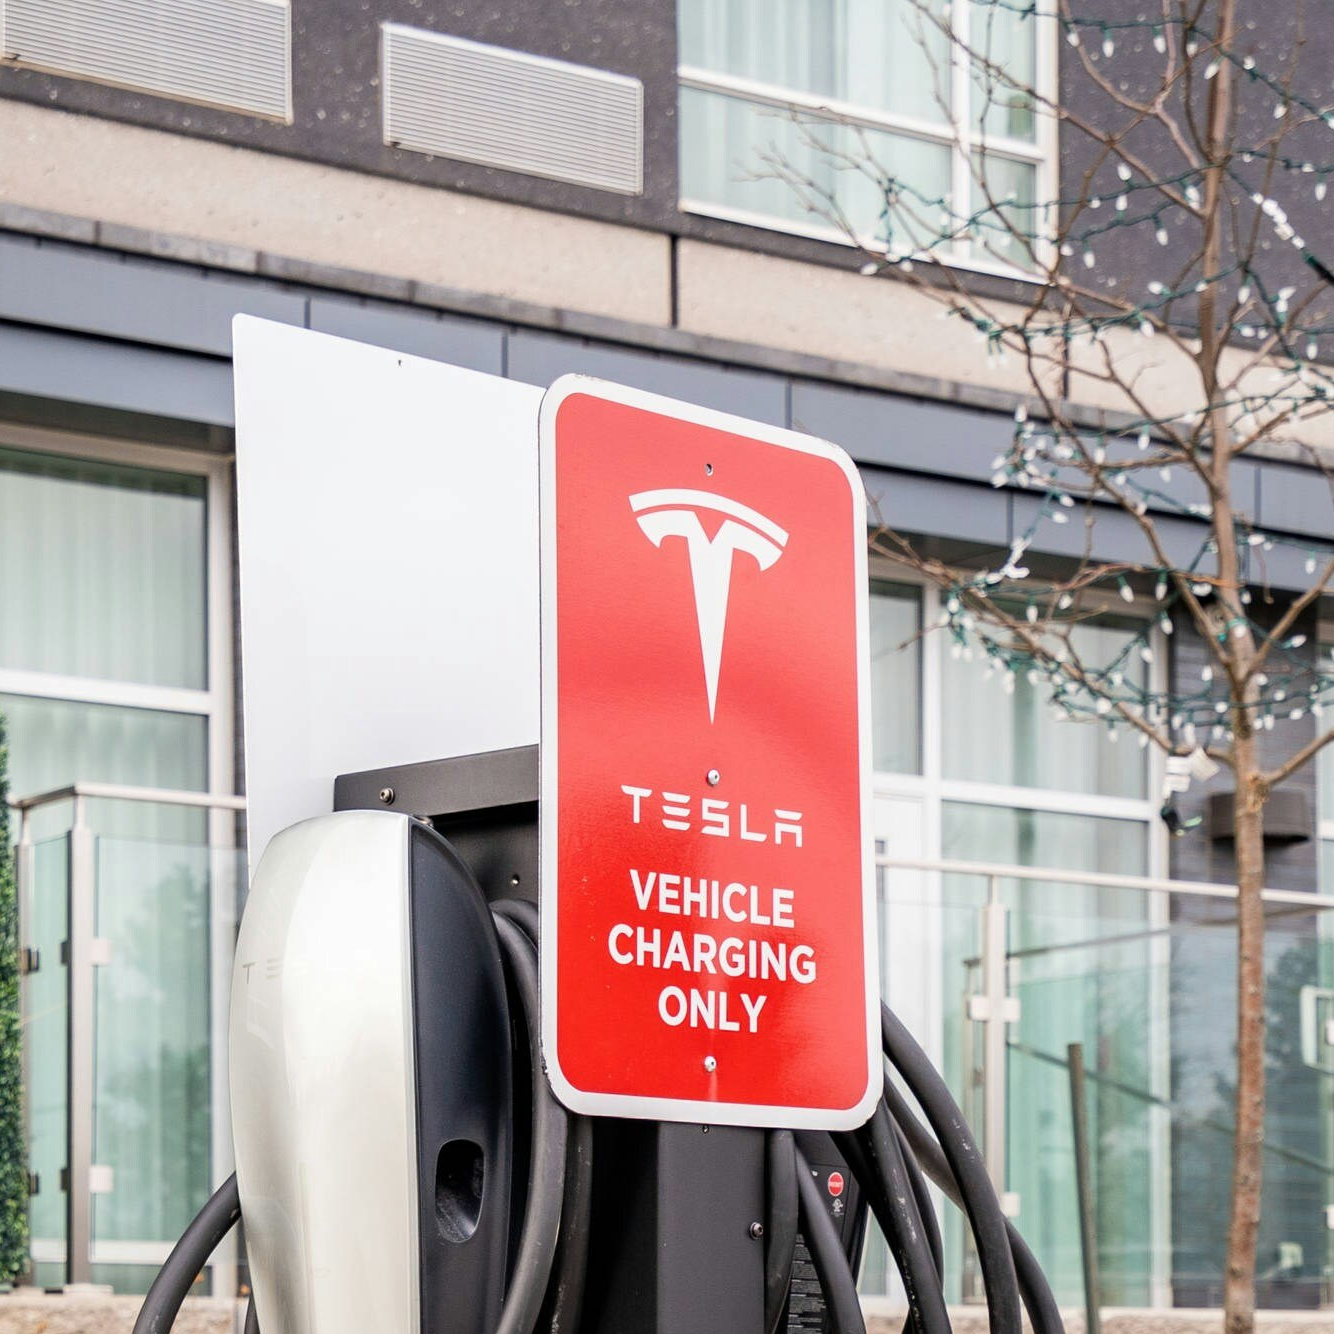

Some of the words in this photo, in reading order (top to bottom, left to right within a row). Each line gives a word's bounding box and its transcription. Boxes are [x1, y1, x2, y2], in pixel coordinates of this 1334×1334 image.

[621, 785, 803, 848] TESLA
[629, 869, 795, 929] VEHICLE
[608, 923, 817, 984] CHARGING
[658, 985, 767, 1033] ONLY
